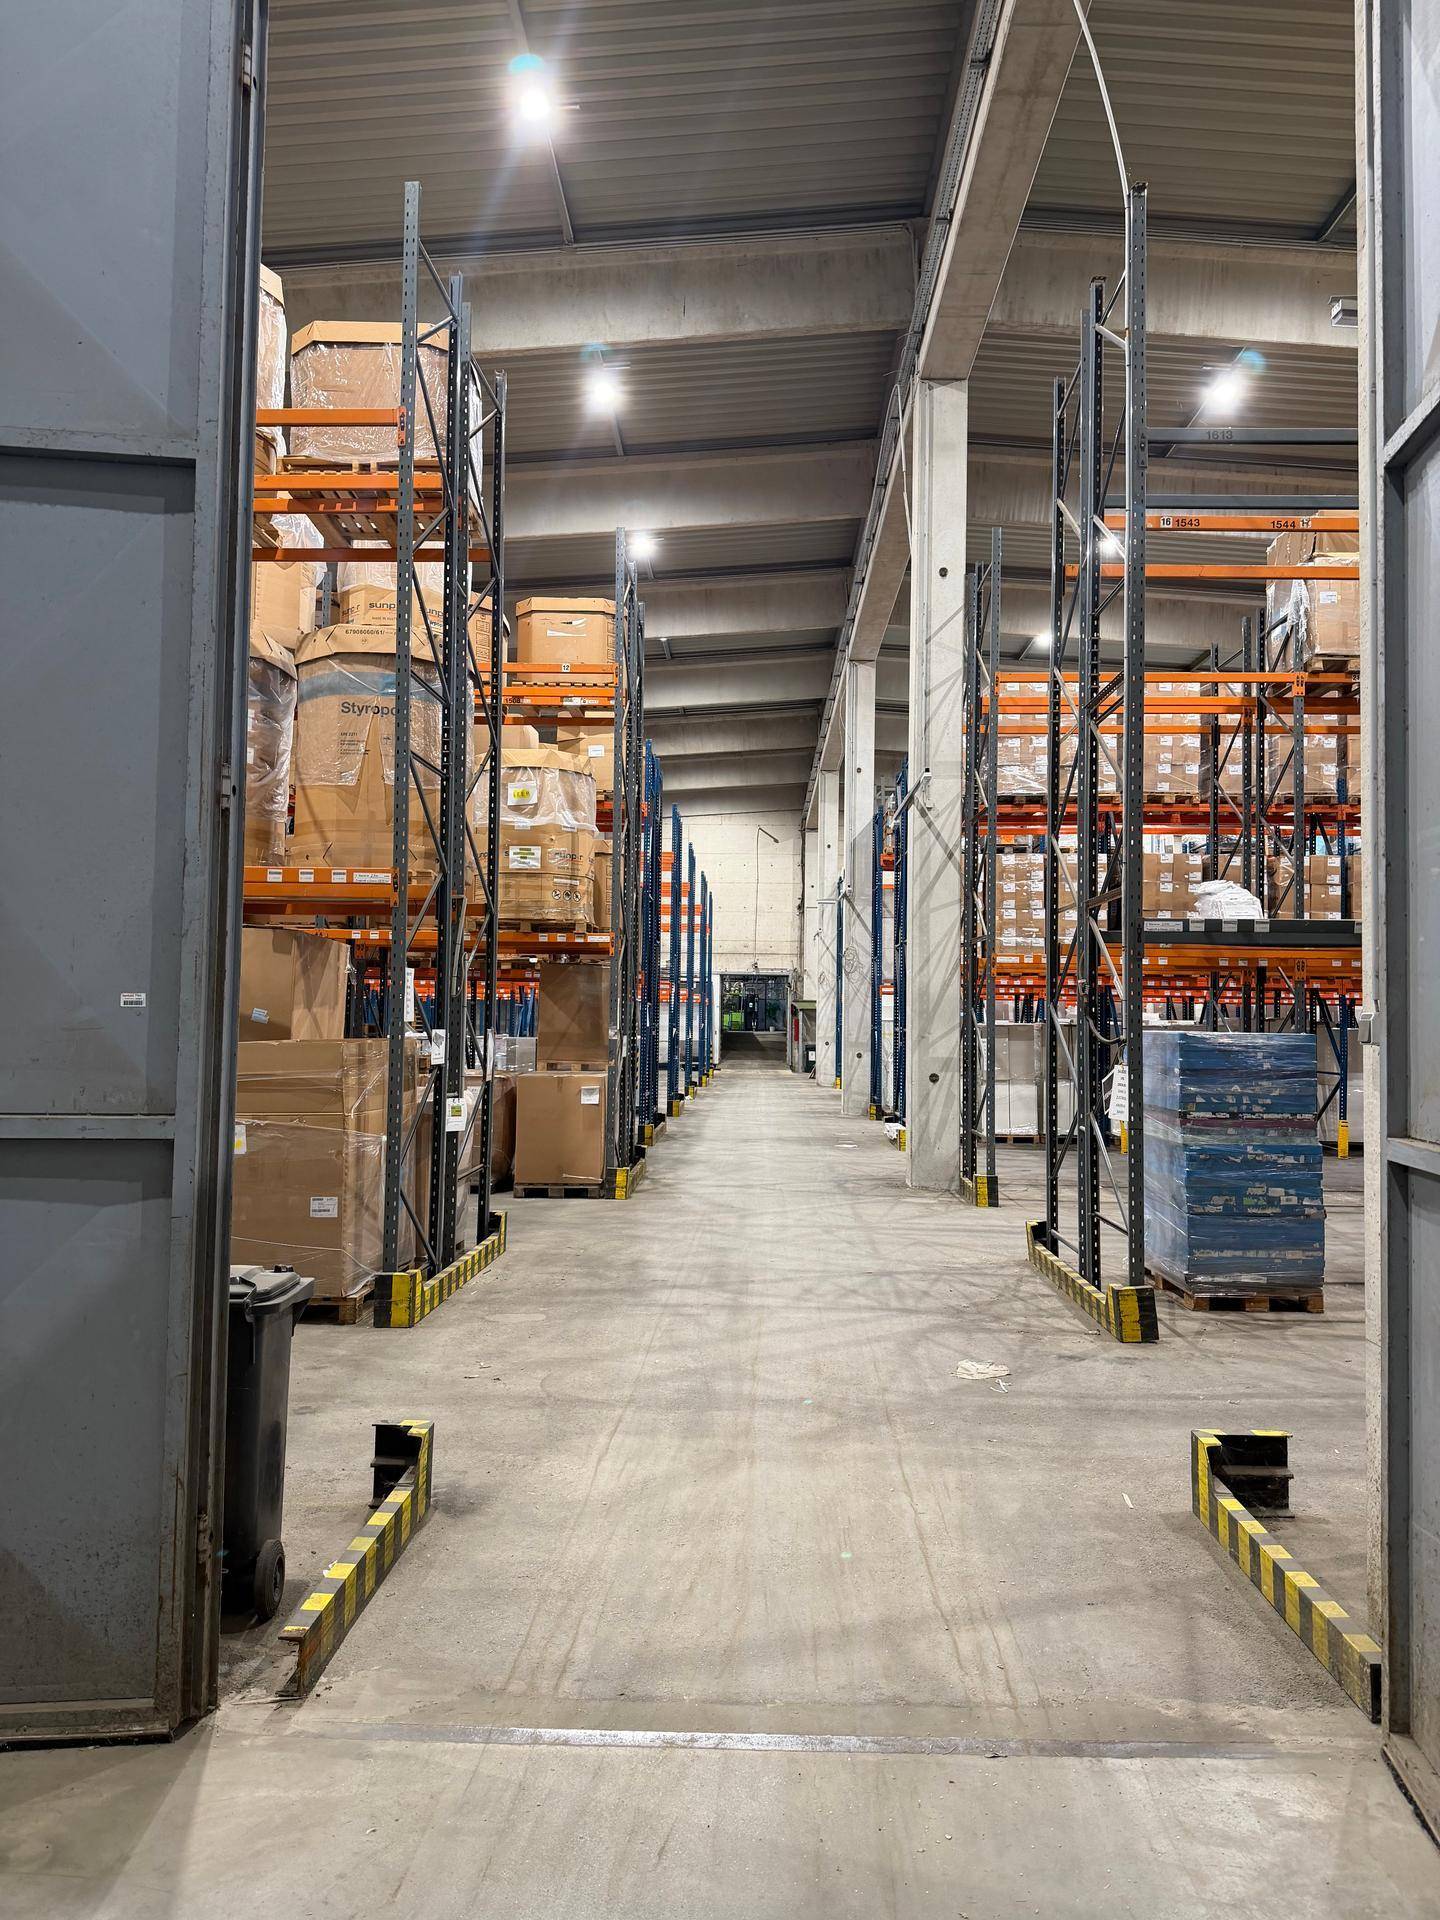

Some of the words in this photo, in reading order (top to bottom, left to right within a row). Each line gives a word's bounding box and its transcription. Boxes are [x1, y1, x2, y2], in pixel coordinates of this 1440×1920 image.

[1206, 429, 1233, 440] 1613
[1161, 517, 1171, 526] 16
[1175, 518, 1200, 527] 1543
[1271, 520, 1296, 529] 1544
[341, 701, 396, 717] Styropo
